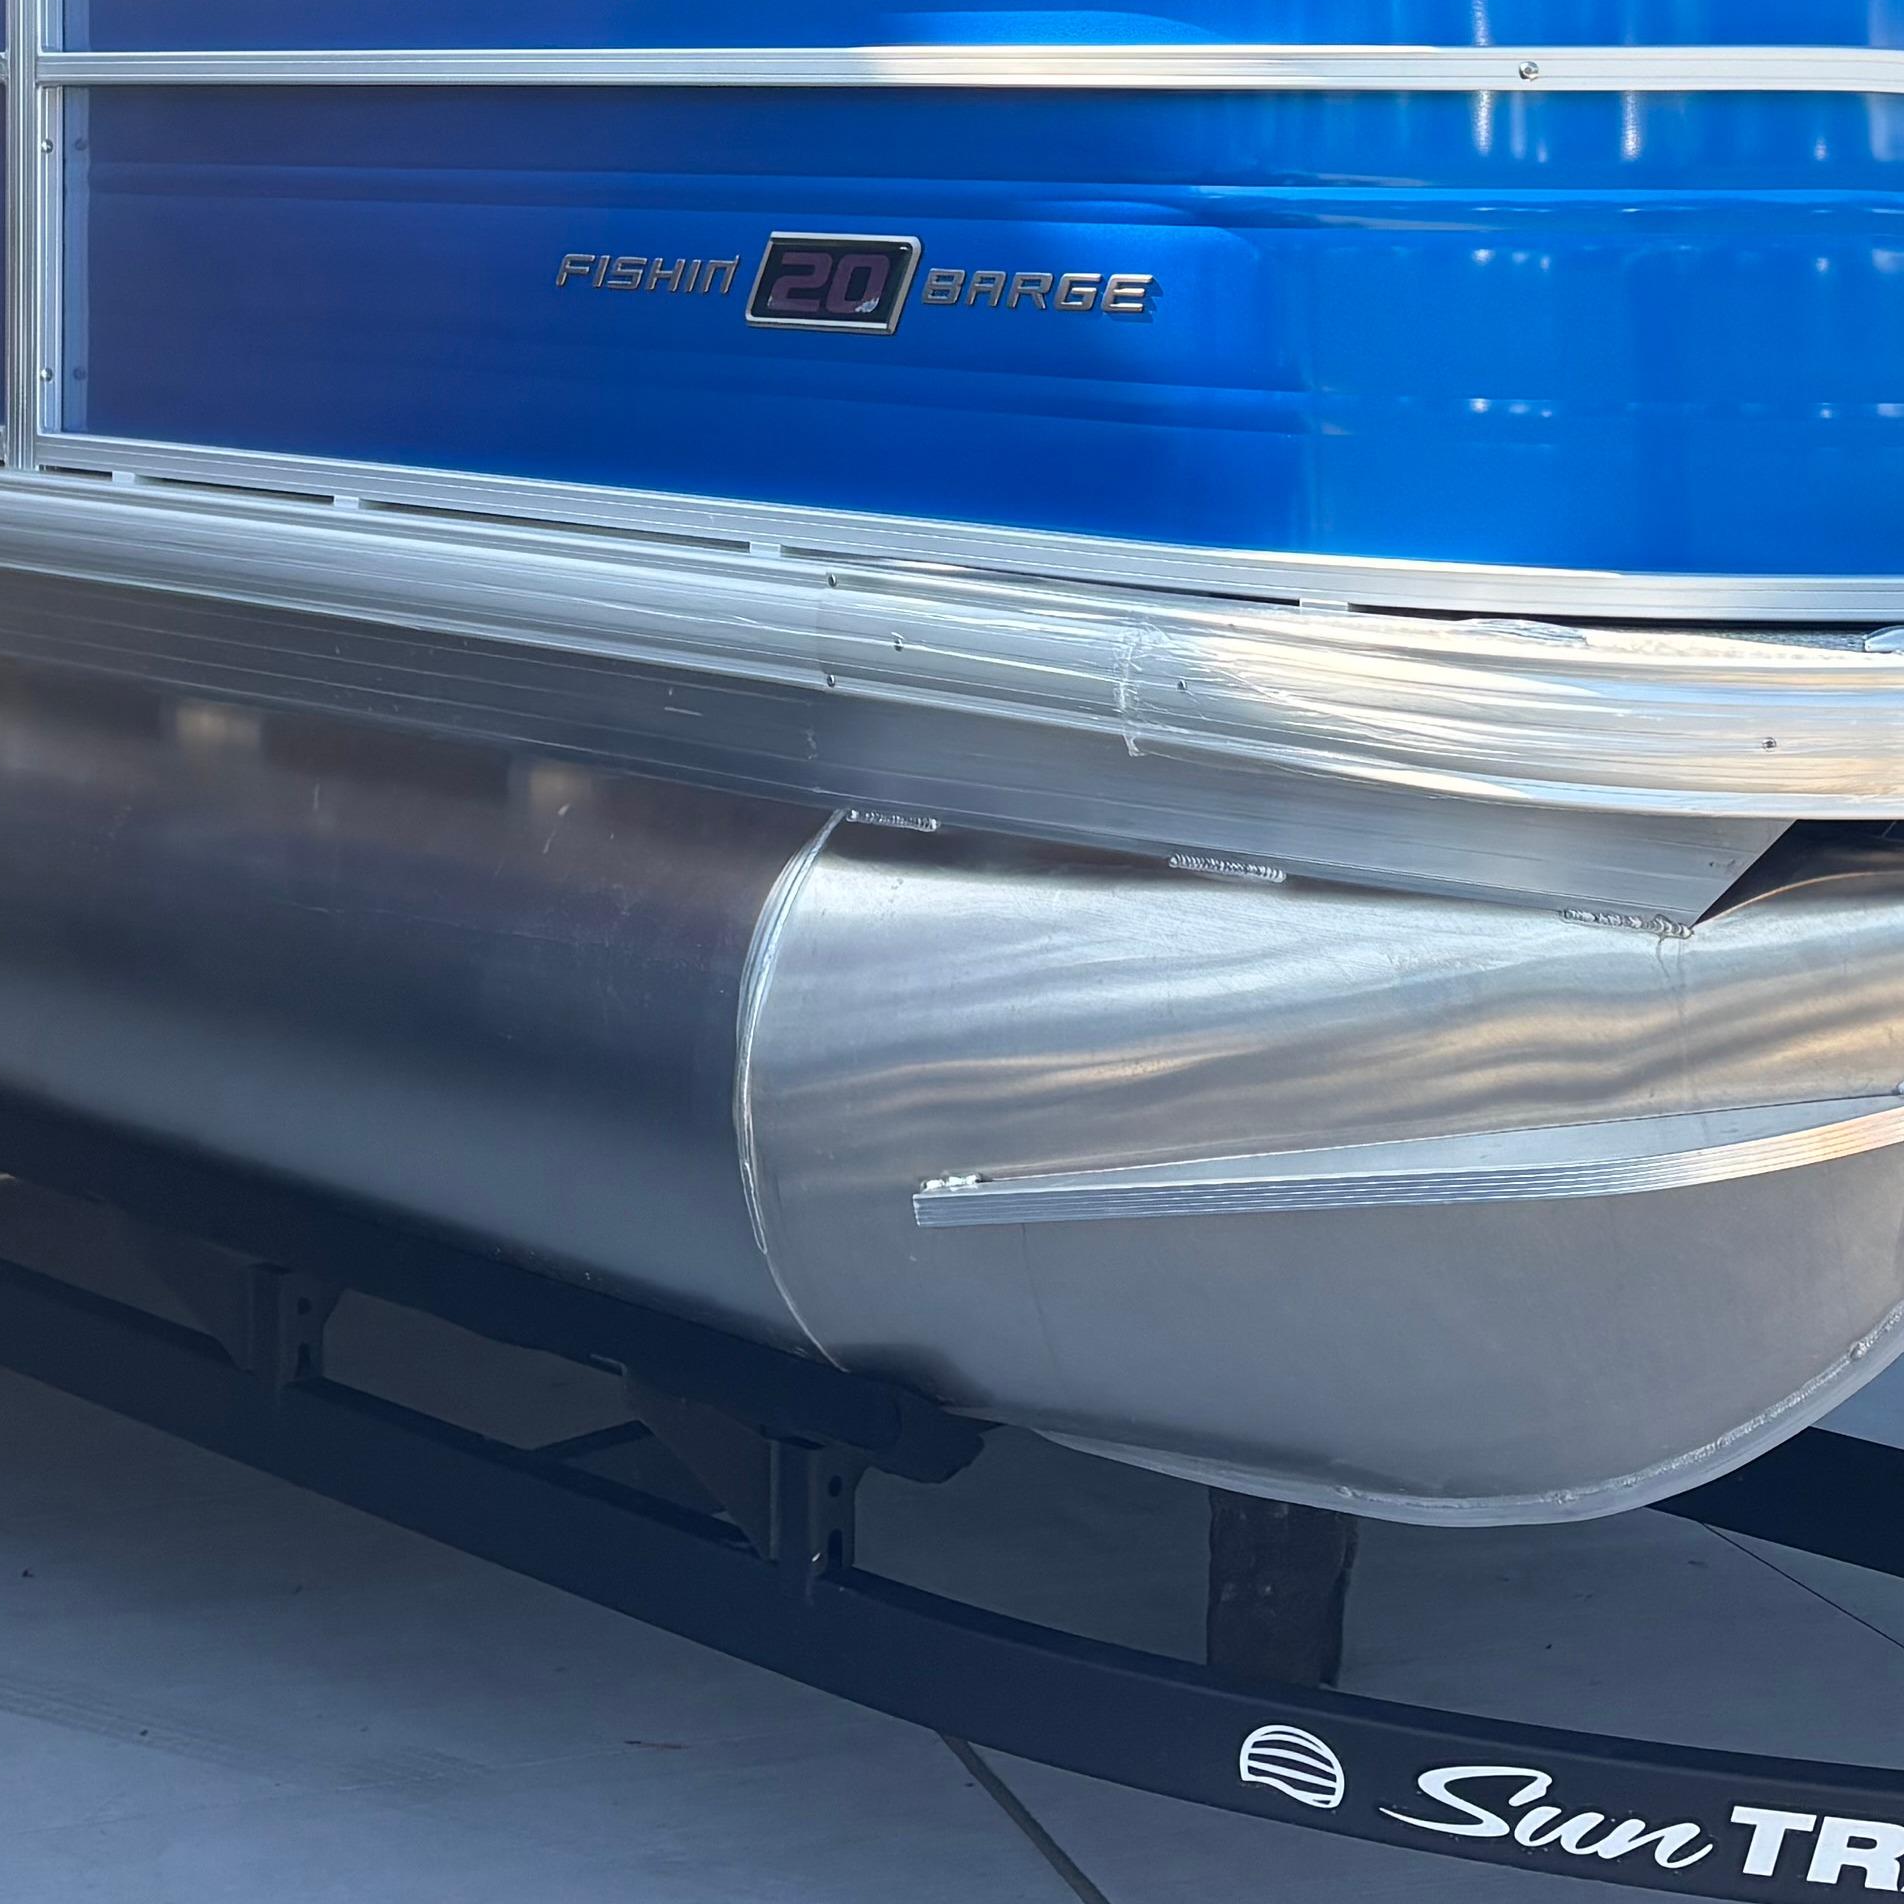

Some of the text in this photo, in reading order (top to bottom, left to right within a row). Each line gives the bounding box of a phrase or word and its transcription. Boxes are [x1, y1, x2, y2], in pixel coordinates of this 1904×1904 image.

[766, 251, 892, 315] 20
[921, 268, 1155, 315] BARGE
[1379, 1765, 1713, 1869] Sun
